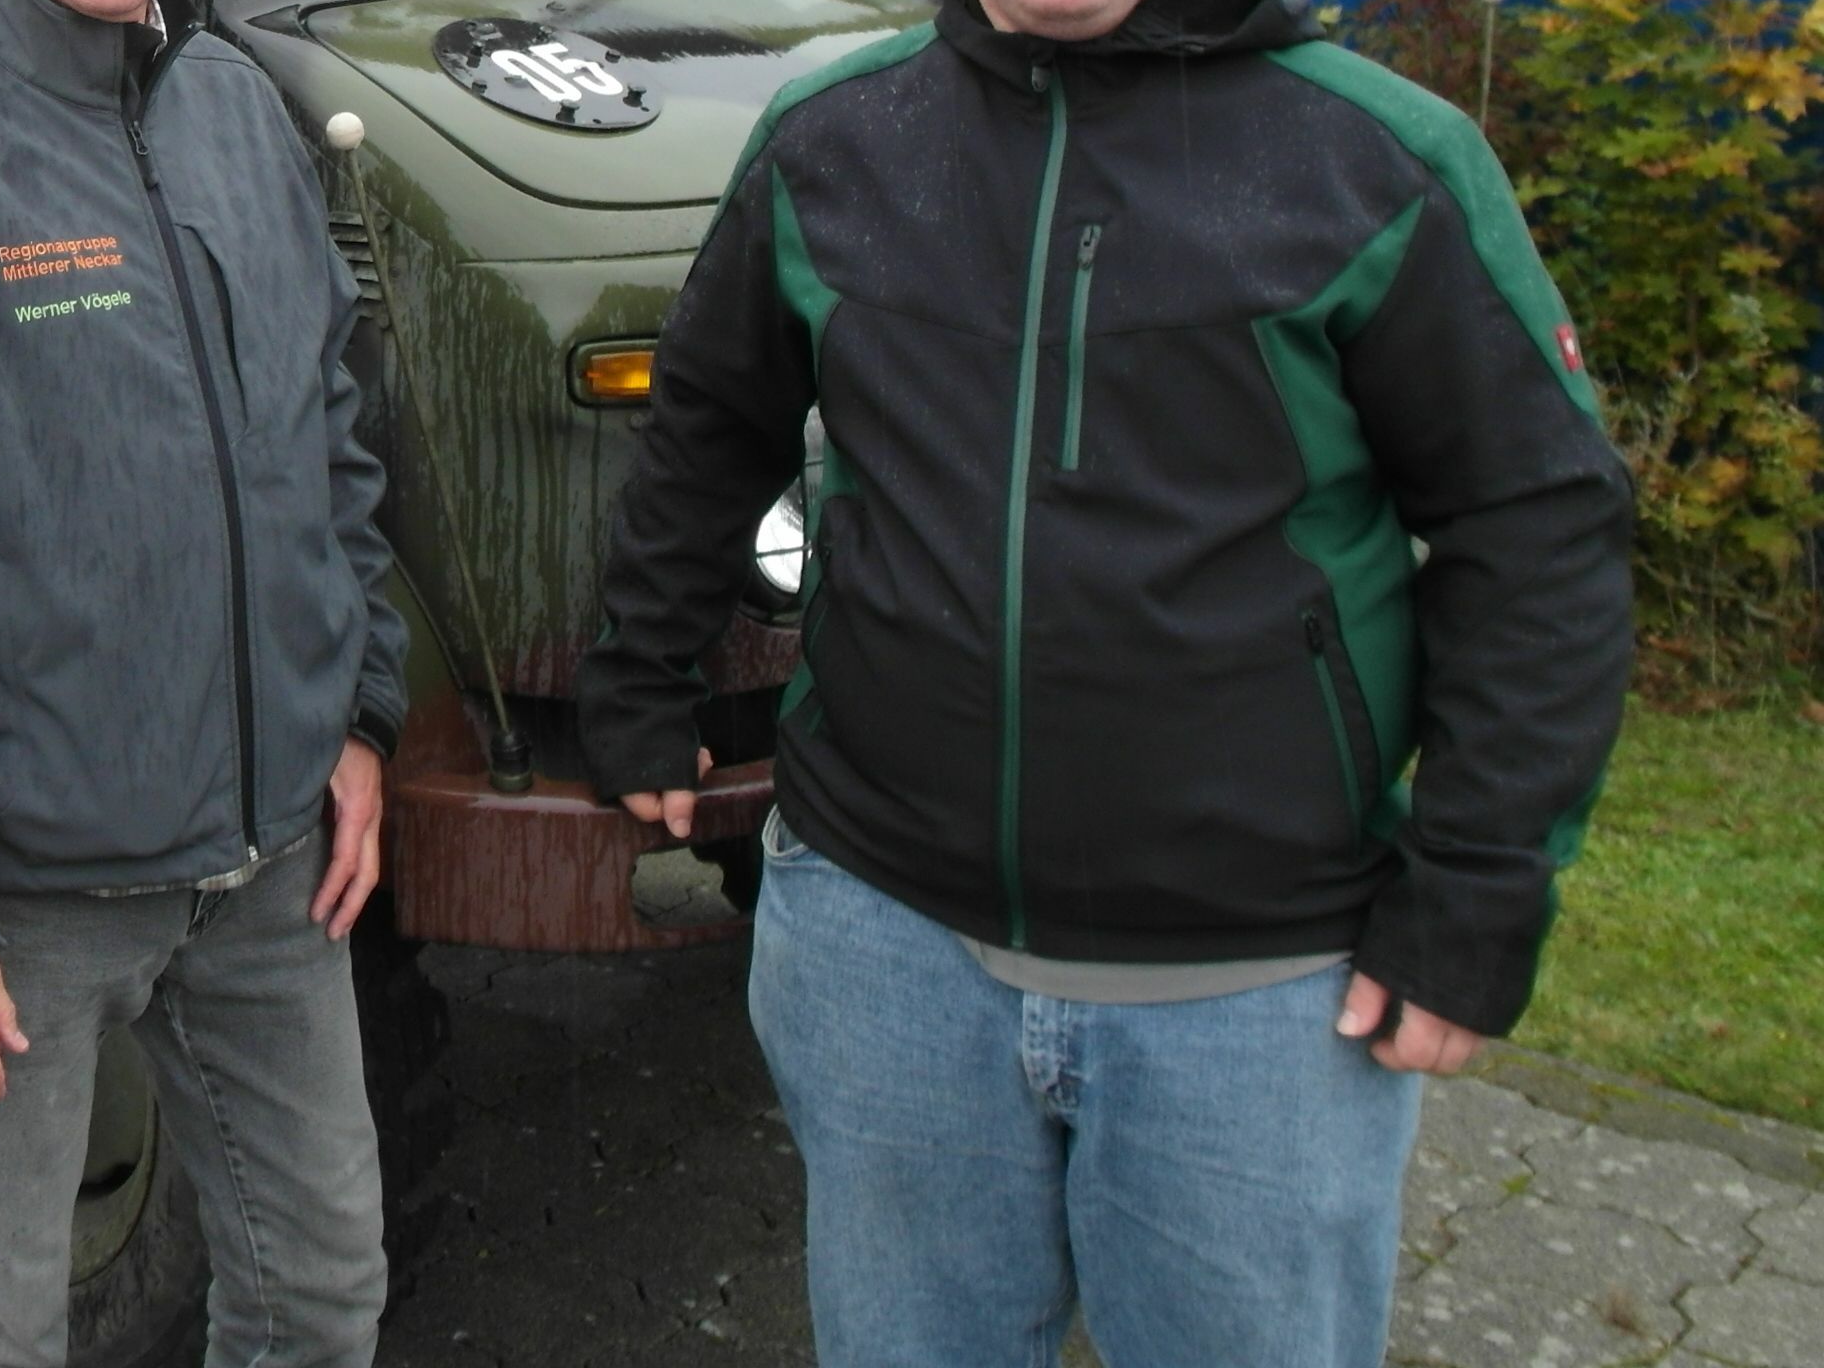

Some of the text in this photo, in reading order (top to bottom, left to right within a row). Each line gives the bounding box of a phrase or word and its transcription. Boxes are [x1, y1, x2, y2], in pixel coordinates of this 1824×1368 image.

[490, 42, 624, 103] 05
[2, 252, 124, 282] Mittlerer Neckar
[14, 289, 132, 324] Werner Vögele
